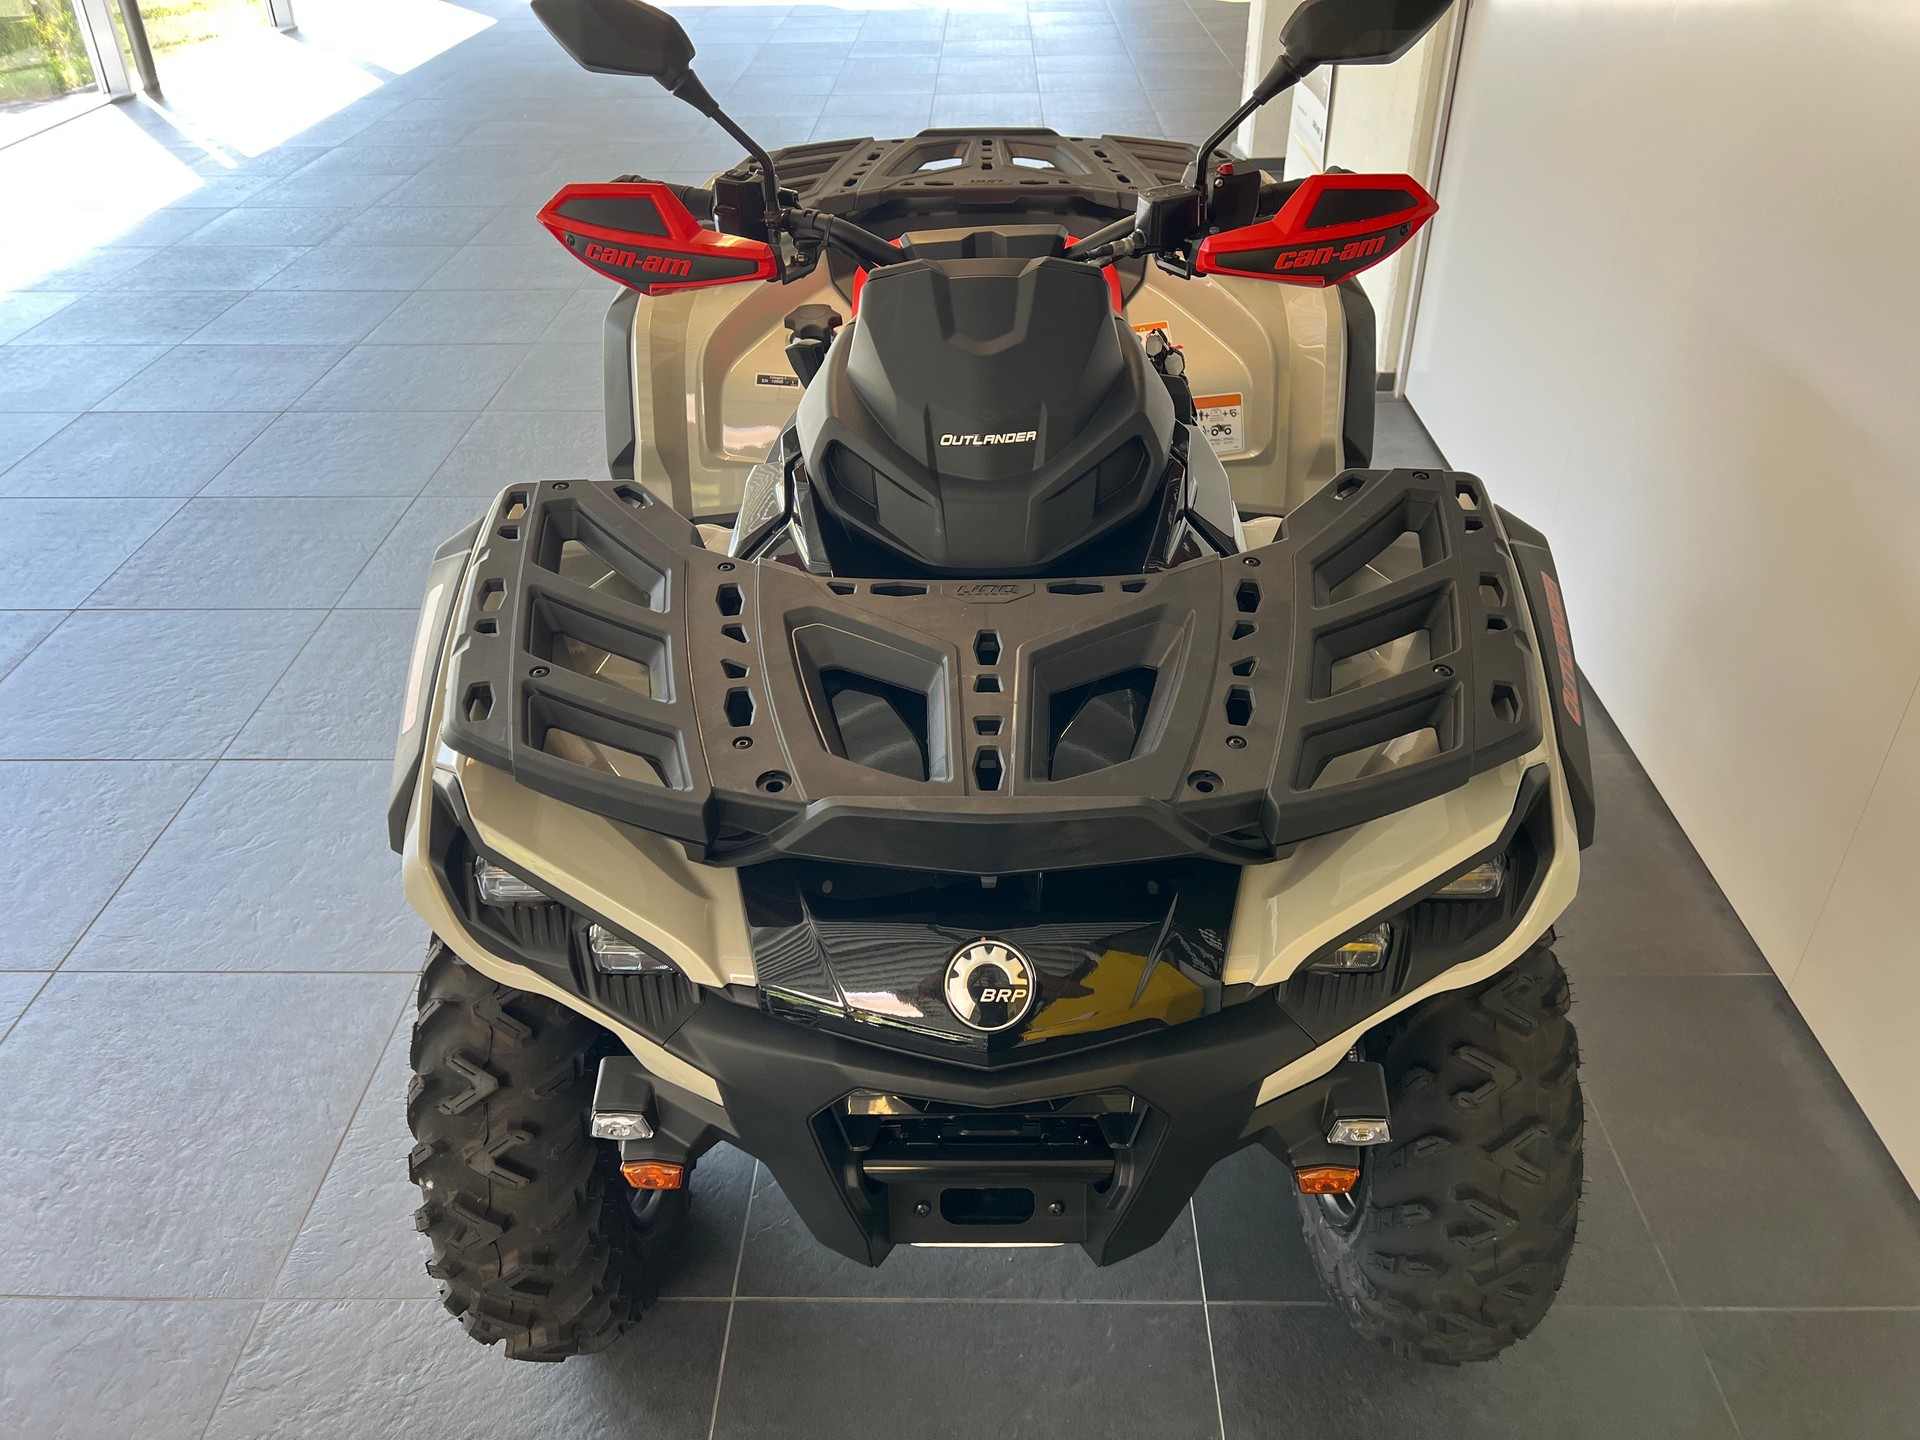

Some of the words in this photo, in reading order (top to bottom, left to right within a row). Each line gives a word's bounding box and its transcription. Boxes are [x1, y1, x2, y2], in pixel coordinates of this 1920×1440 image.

[584, 243, 692, 277] can-am
[1274, 235, 1386, 270] can-am
[980, 988, 1028, 1003] BRP
